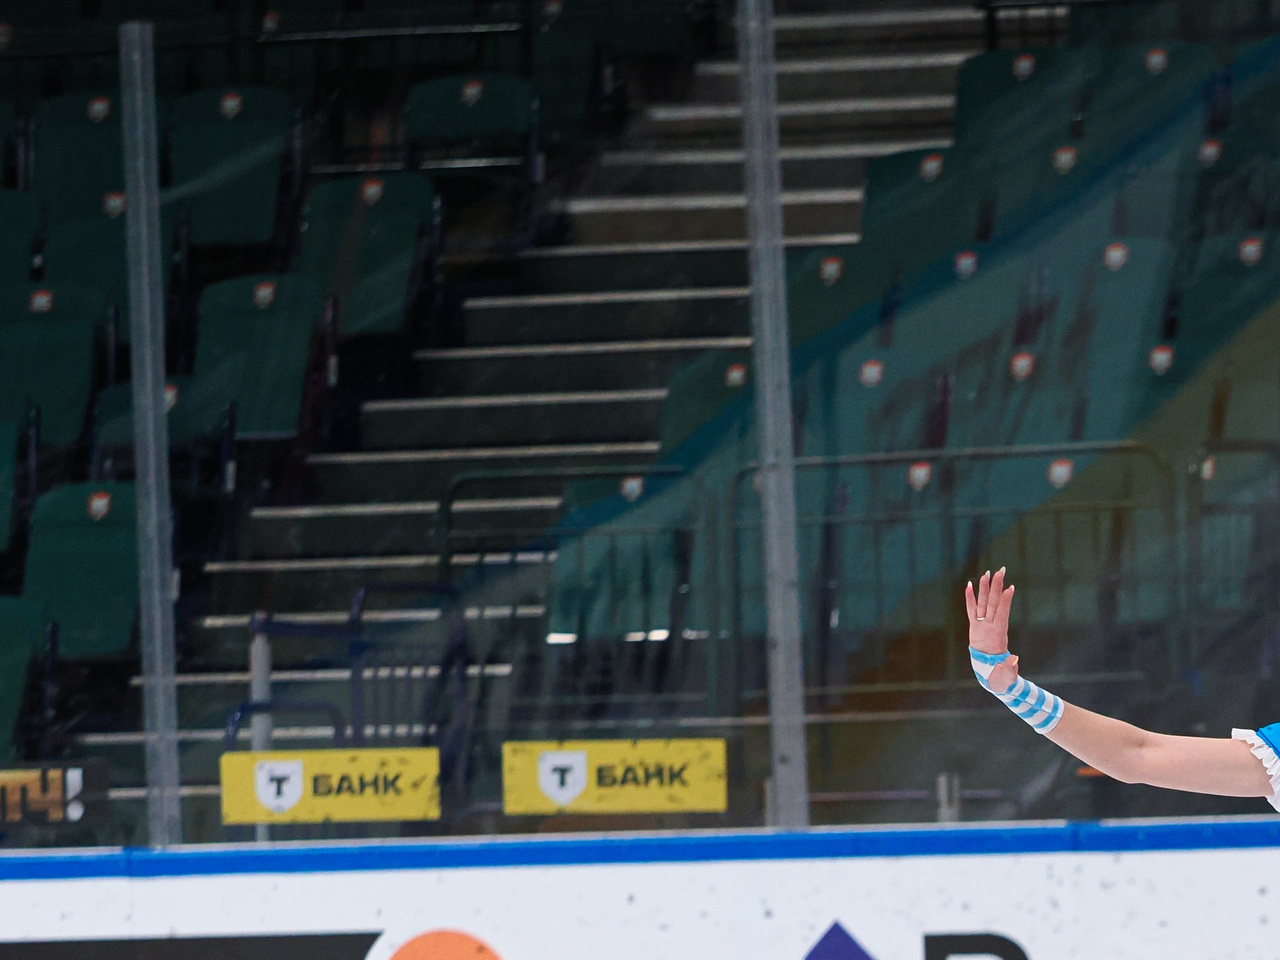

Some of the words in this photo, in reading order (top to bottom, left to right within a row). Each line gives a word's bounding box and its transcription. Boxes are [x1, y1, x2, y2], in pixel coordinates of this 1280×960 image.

[269, 774, 290, 797] Т
[312, 772, 403, 797] БАНК
[552, 764, 573, 788] Т
[597, 763, 688, 788] БАНК
[0, 767, 84, 822] ТЧ!
